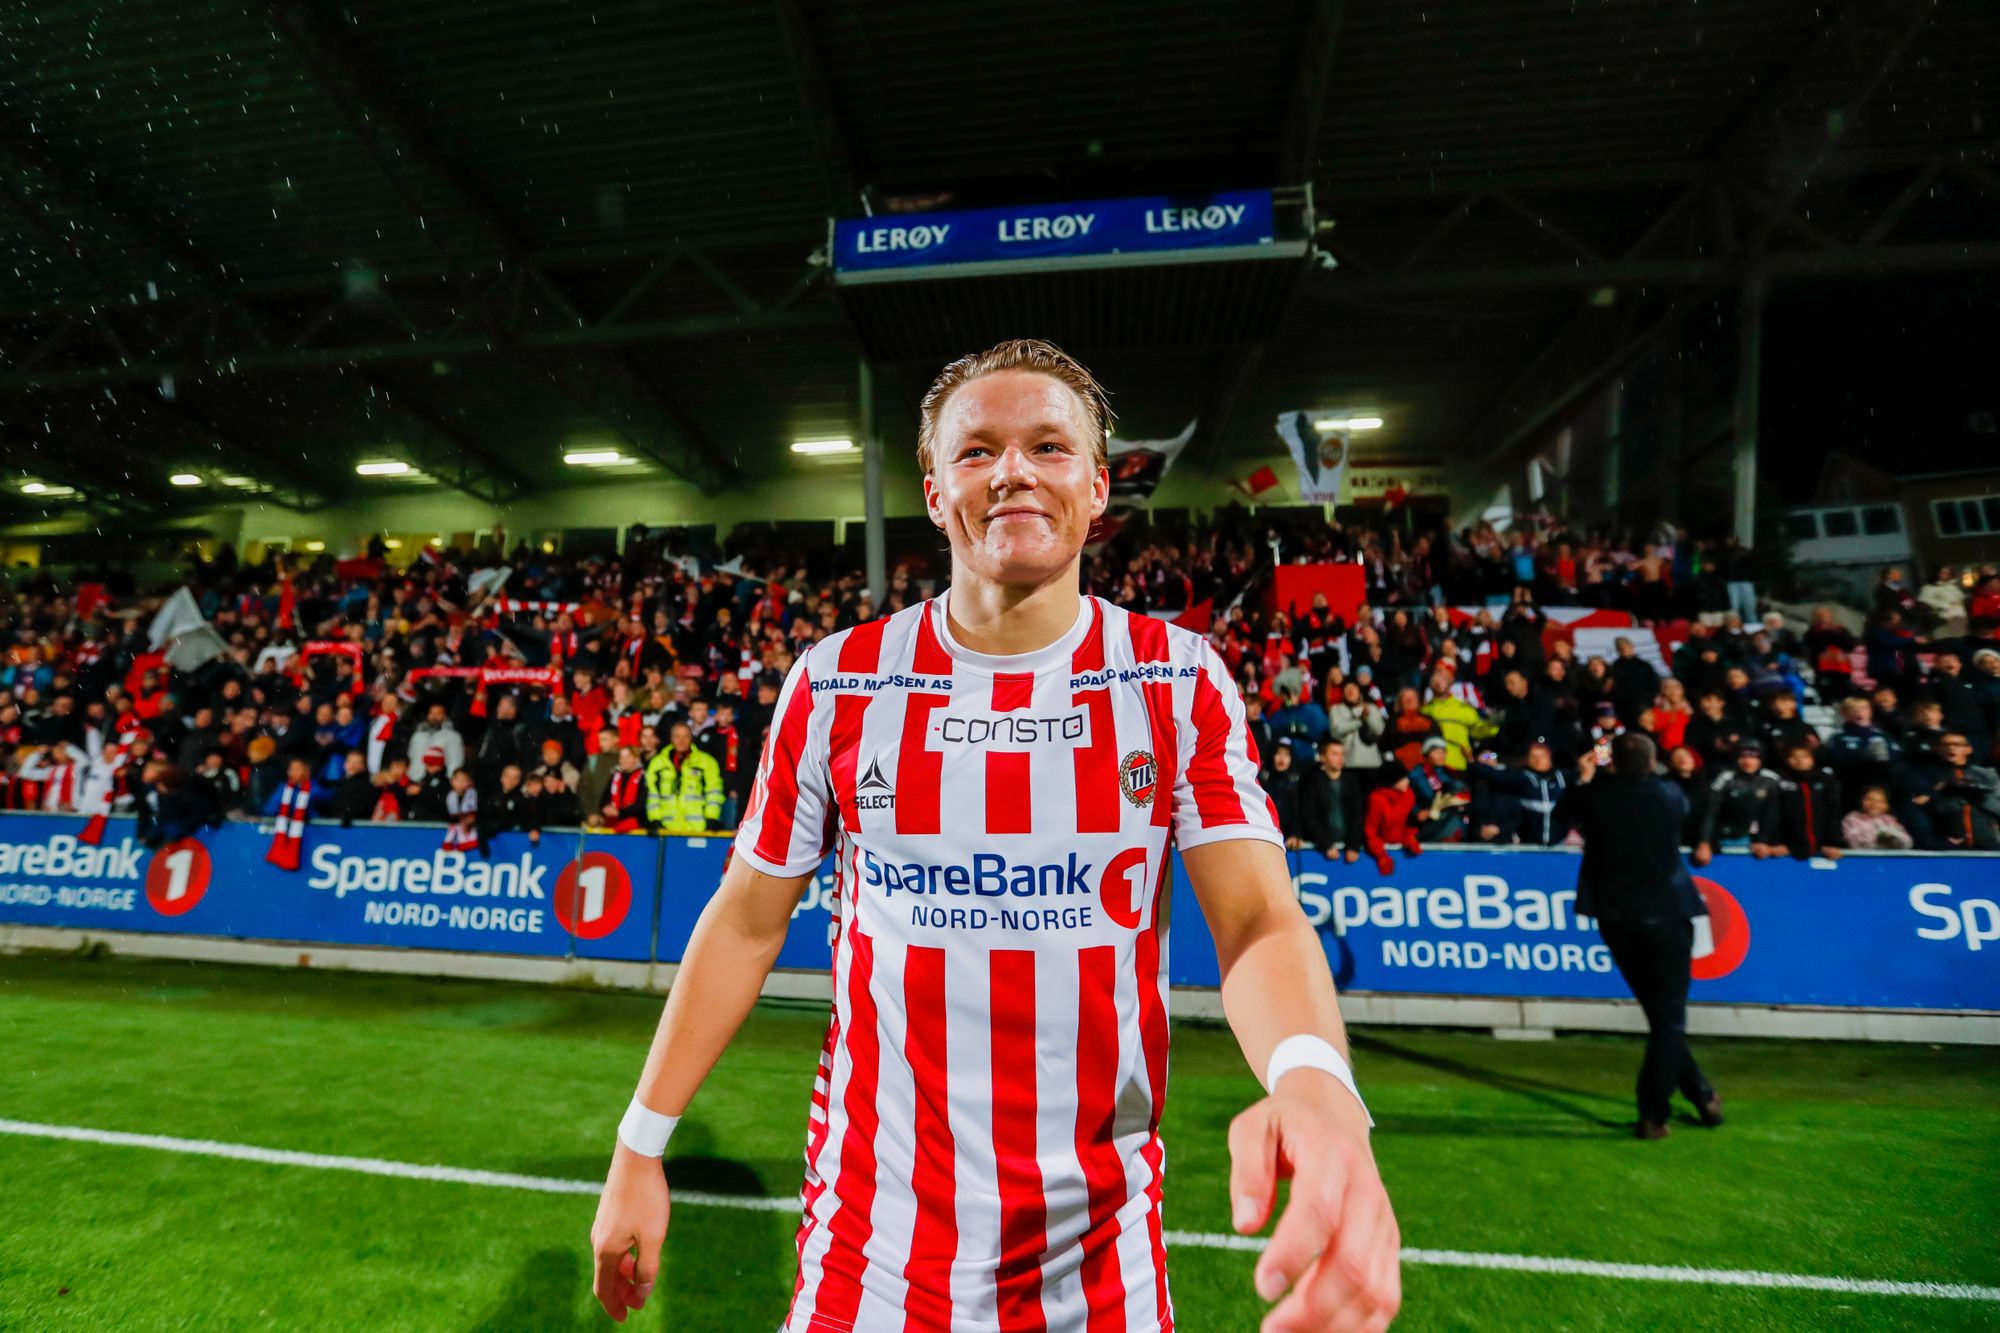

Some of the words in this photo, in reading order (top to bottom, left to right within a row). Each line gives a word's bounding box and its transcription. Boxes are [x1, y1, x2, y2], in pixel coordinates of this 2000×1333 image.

[857, 224, 950, 254] LERØY
[998, 213, 1095, 242] LERØY
[1145, 204, 1245, 234] LERØY
[810, 678, 859, 693] ROALD
[930, 679, 953, 690] AS
[1070, 668, 1116, 689] ROALD
[1178, 666, 1199, 678] AS
[1130, 765, 1152, 790] TIL
[853, 794, 896, 810] SELECT
[308, 844, 548, 899] SpareBank
[578, 866, 607, 923] 1
[864, 850, 1093, 897] SpareBank
[364, 901, 545, 933] NORD-NORGE
[911, 905, 1093, 931] NORD-NORGE
[1292, 872, 1599, 937] SpareBan
[1381, 939, 1613, 973] NORD-NORG
